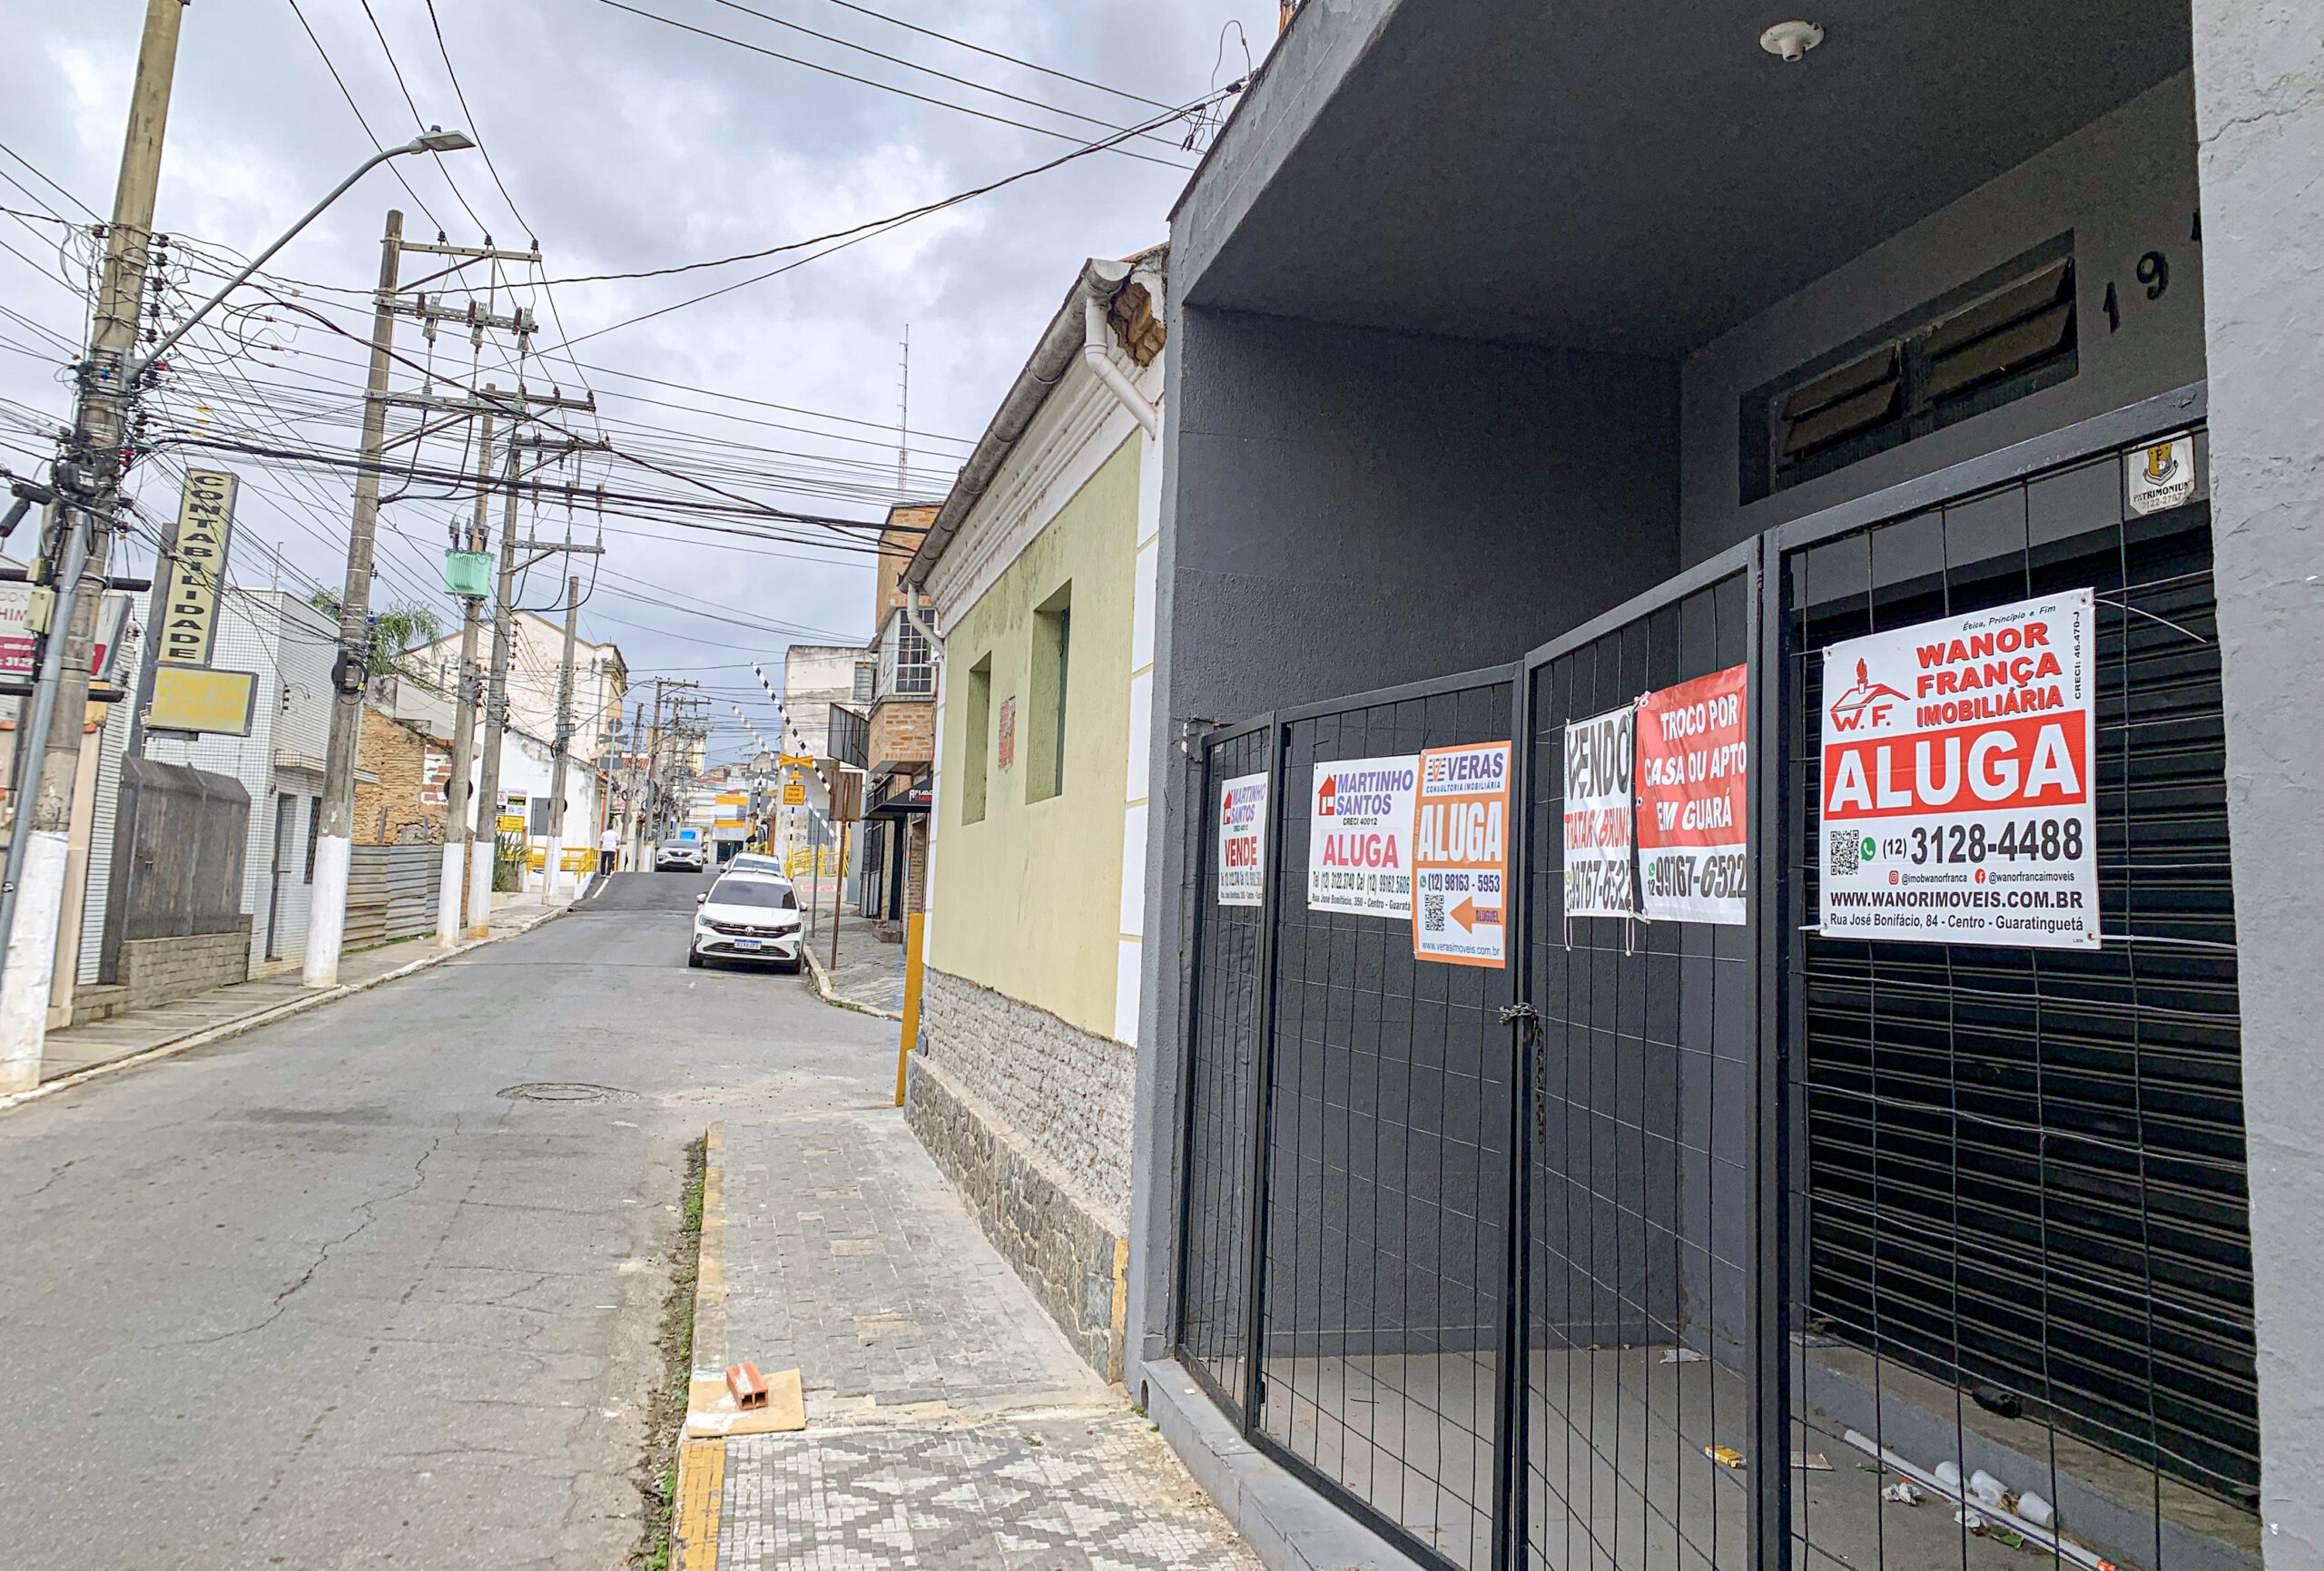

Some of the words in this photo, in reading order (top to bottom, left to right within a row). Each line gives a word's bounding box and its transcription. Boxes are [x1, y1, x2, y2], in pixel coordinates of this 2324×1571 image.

[169, 476, 225, 660] CONTABILIDADE
[1988, 611, 2025, 626] Princípio
[2039, 604, 2056, 614] Fim
[1916, 622, 2049, 669] WANOR
[1916, 652, 2063, 699] FRANÇA
[1660, 708, 1706, 741] TROCO
[1709, 693, 1738, 731] POR
[1916, 684, 2065, 728] IMOBILIÁRIA
[1448, 752, 1503, 781] VERAS
[1644, 755, 1685, 788] CASA
[1688, 751, 1708, 784] OU
[1710, 741, 1747, 781] APTO
[1827, 723, 2081, 812] ALUGA
[1337, 770, 1413, 793] MARTINHO
[1426, 783, 1462, 793] CONSULTORIA
[1232, 782, 1266, 806] MARTINHO
[1336, 794, 1392, 815] SANTOS
[1231, 804, 1255, 824] SANTOS
[1656, 801, 1679, 832] EM
[1681, 787, 1733, 832] GUARÁ
[1344, 818, 1359, 826] CRECI
[1360, 818, 1378, 826] 40012
[1417, 801, 1502, 862] ALUGA
[1564, 809, 1595, 850] TRATAR
[1225, 836, 1257, 867] VENDE
[1323, 834, 1399, 869] ALUGA
[1883, 838, 1907, 859] (12)
[1911, 818, 2083, 865] 3128-4488
[1321, 871, 1329, 891] (12)
[1331, 871, 1354, 890] 3122.3740
[1356, 872, 1364, 890] Cel
[1366, 873, 1377, 895] (12)
[1428, 873, 1443, 891] (12)
[1445, 874, 1469, 891] 98163
[1478, 875, 1500, 892] 5953
[1647, 879, 1657, 897] 12
[1902, 872, 1967, 885] @imobwanorfranca
[1988, 871, 2075, 885] @wanorfrancaimoveis
[1312, 893, 1320, 902] Rua
[1321, 894, 1330, 903] José
[1367, 898, 1384, 908] Centro
[1830, 891, 2083, 908] WWW.WANORIMOVEIS.COM.BR
[1475, 909, 1500, 923] ALUGUEL
[1830, 913, 1847, 927] Rua
[1849, 913, 1872, 927] José
[1874, 914, 1923, 928] Bonifácio,
[1925, 915, 1938, 928] 84
[1948, 915, 1985, 928] Centro
[1995, 915, 2083, 934] Guaratinguetá
[1422, 942, 1500, 957] www.verasimoveis.com.br
